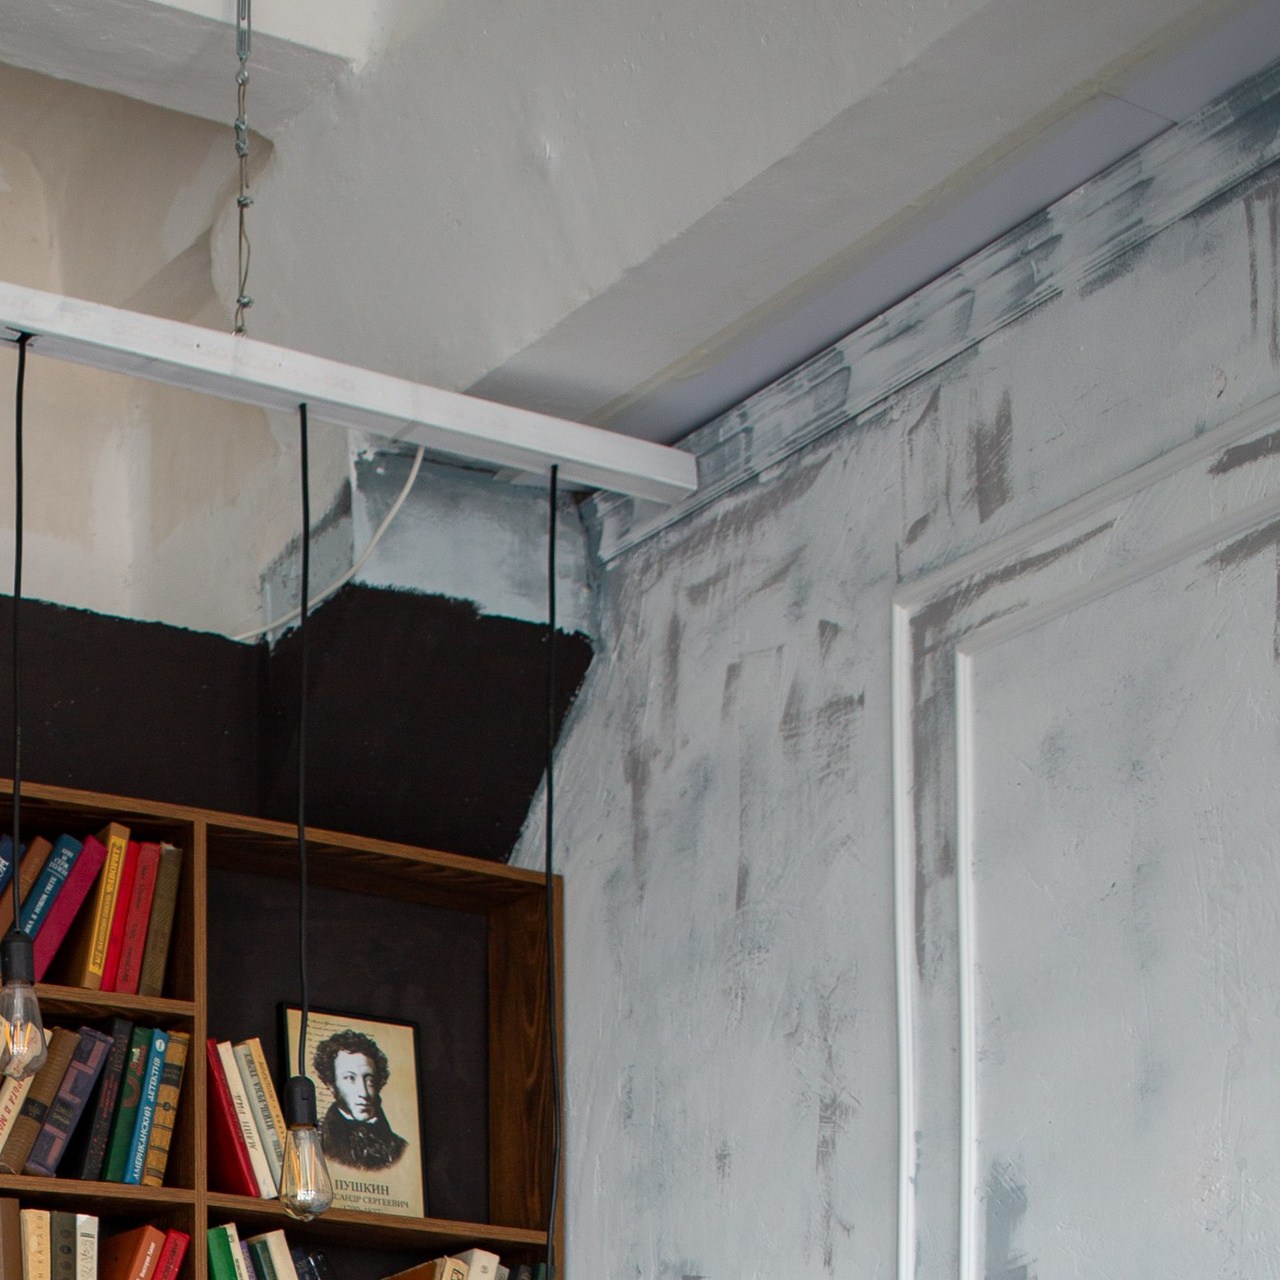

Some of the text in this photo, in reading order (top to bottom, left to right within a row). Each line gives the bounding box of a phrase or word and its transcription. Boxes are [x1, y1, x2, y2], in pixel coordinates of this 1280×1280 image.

[130, 1058, 161, 1180] АМЕРИКАНСКИЙ ДЕТЕКТИВ
[233, 1092, 257, 1151] МАЙН РИД
[335, 1180, 389, 1195] ПУШКИН
[363, 1196, 409, 1208] СЕРГЕЕВИЧ
[36, 1215, 44, 1264] КАТАЕВ
